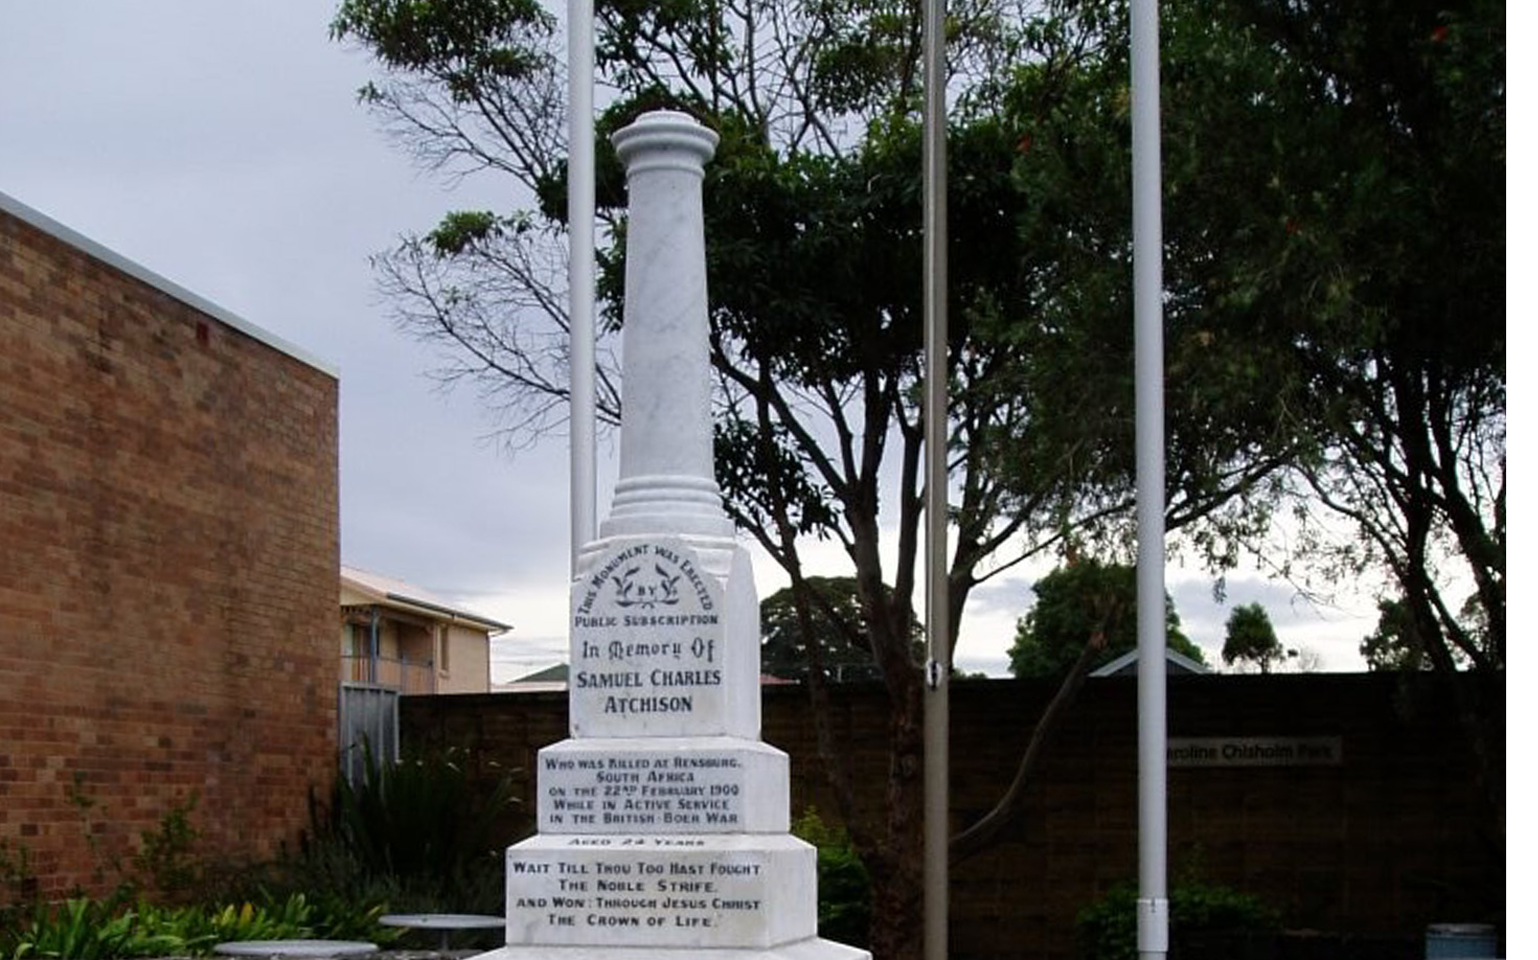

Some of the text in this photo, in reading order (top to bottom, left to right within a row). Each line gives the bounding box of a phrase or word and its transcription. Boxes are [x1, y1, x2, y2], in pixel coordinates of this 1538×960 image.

[578, 544, 713, 614] THIS MONUMENT WAS ERECTED
[638, 586, 654, 596] BY
[575, 615, 718, 627] PUBLIC SUBSCRIPTION
[583, 638, 713, 663] In Memory Of
[577, 670, 721, 688] SAMUEL CHARLES
[605, 697, 692, 713] ATCHISON
[546, 759, 574, 769] WHO
[578, 760, 604, 769] WAS
[609, 758, 649, 768] KILLED
[654, 759, 668, 768] AT
[597, 771, 693, 783] SOUTH AFRICA
[549, 787, 565, 796] ON
[574, 788, 595, 796] THE
[642, 786, 704, 796] FEBRUARY
[711, 784, 739, 796] 1900
[554, 799, 728, 810] WHILE IN ACTIVE SERVICE
[550, 815, 562, 823] IN
[573, 815, 594, 824] THE
[706, 813, 737, 823] WAR
[514, 862, 760, 875] WAIT TILL THOU TOO HAST FOUGHT
[560, 879, 585, 891] THE
[598, 880, 643, 891] NOBLE
[517, 899, 547, 907] AND
[596, 897, 656, 908] THROUGH
[662, 898, 706, 908] JESUS
[712, 898, 760, 910] CHRIST
[549, 914, 575, 926] THE
[587, 914, 639, 926] CROWN
[647, 917, 665, 926] OF
